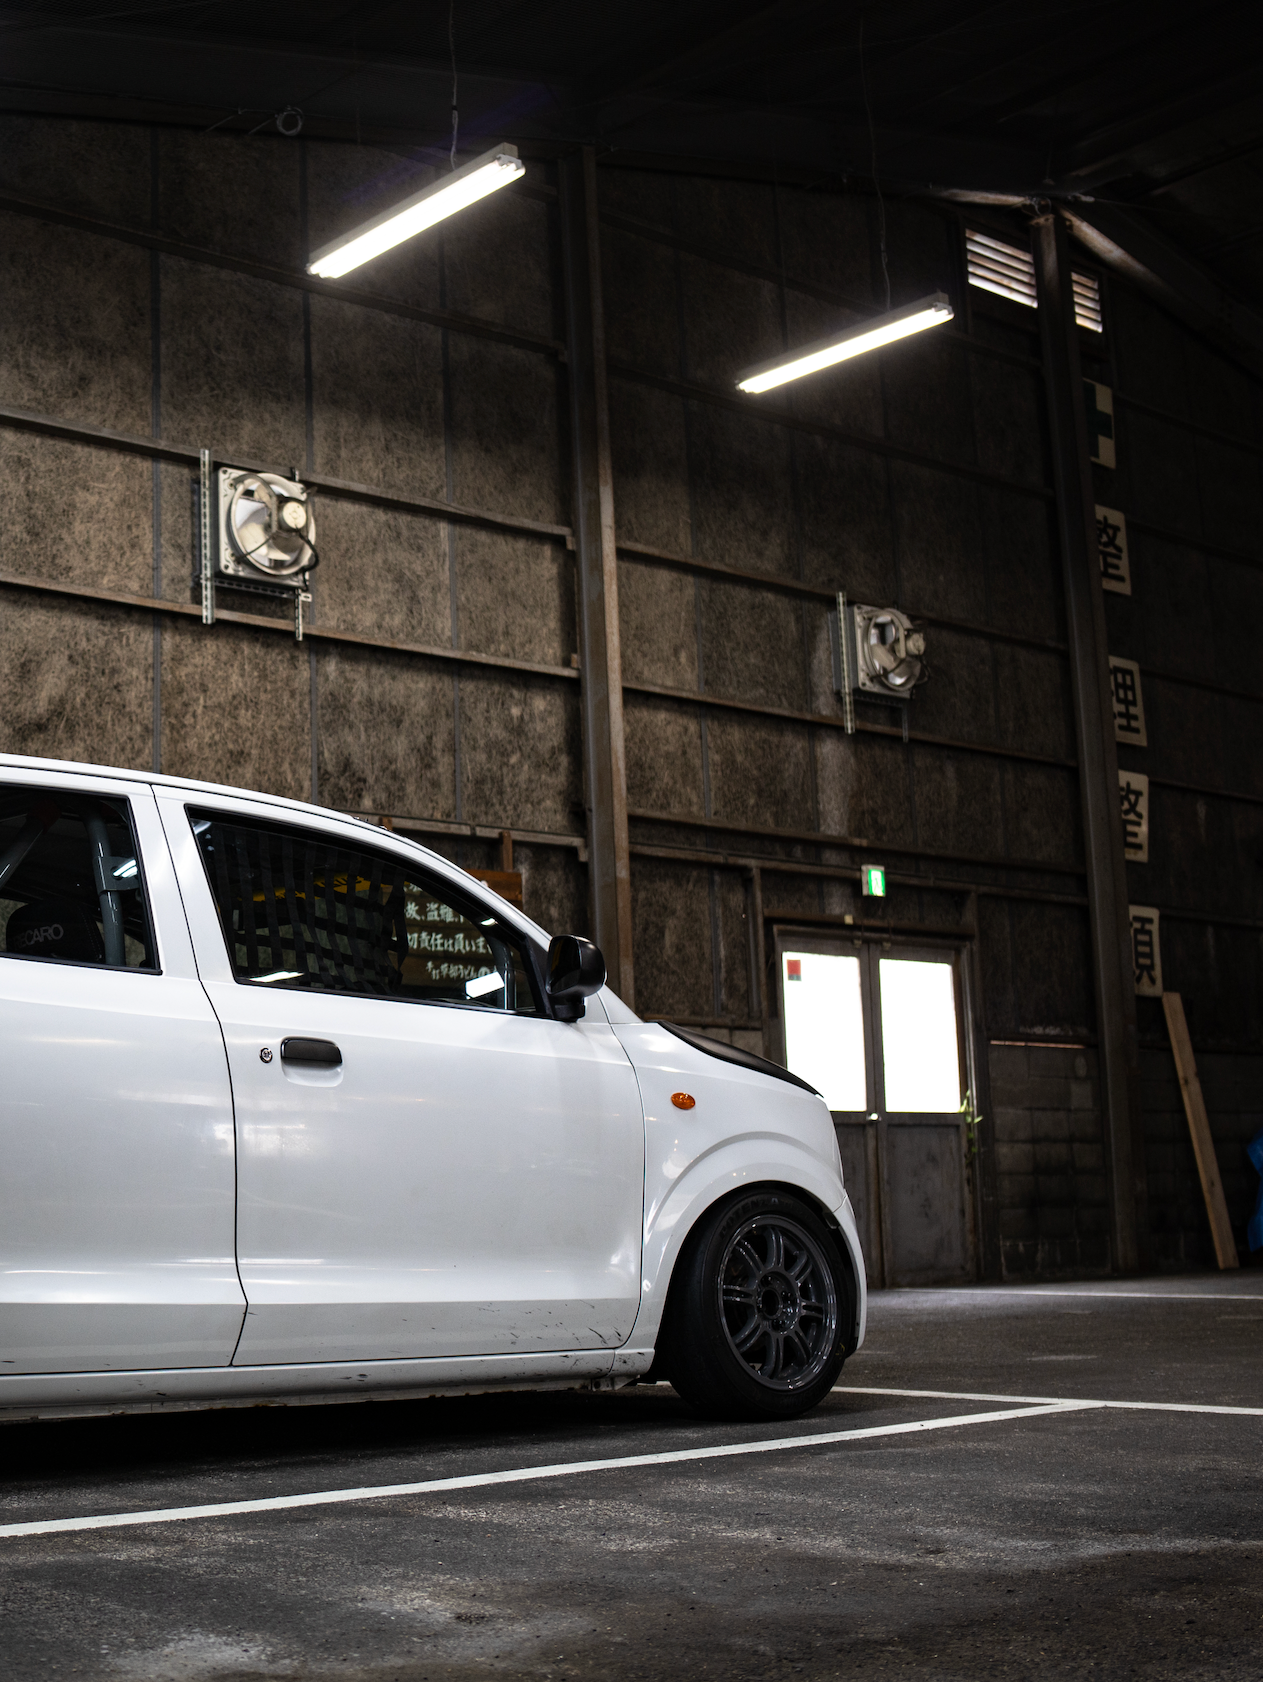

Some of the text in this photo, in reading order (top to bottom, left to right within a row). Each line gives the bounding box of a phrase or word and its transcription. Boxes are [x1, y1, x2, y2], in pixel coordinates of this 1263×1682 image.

[13, 923, 64, 951] RECARO
[391, 931, 494, 955] 切責任は負いま
